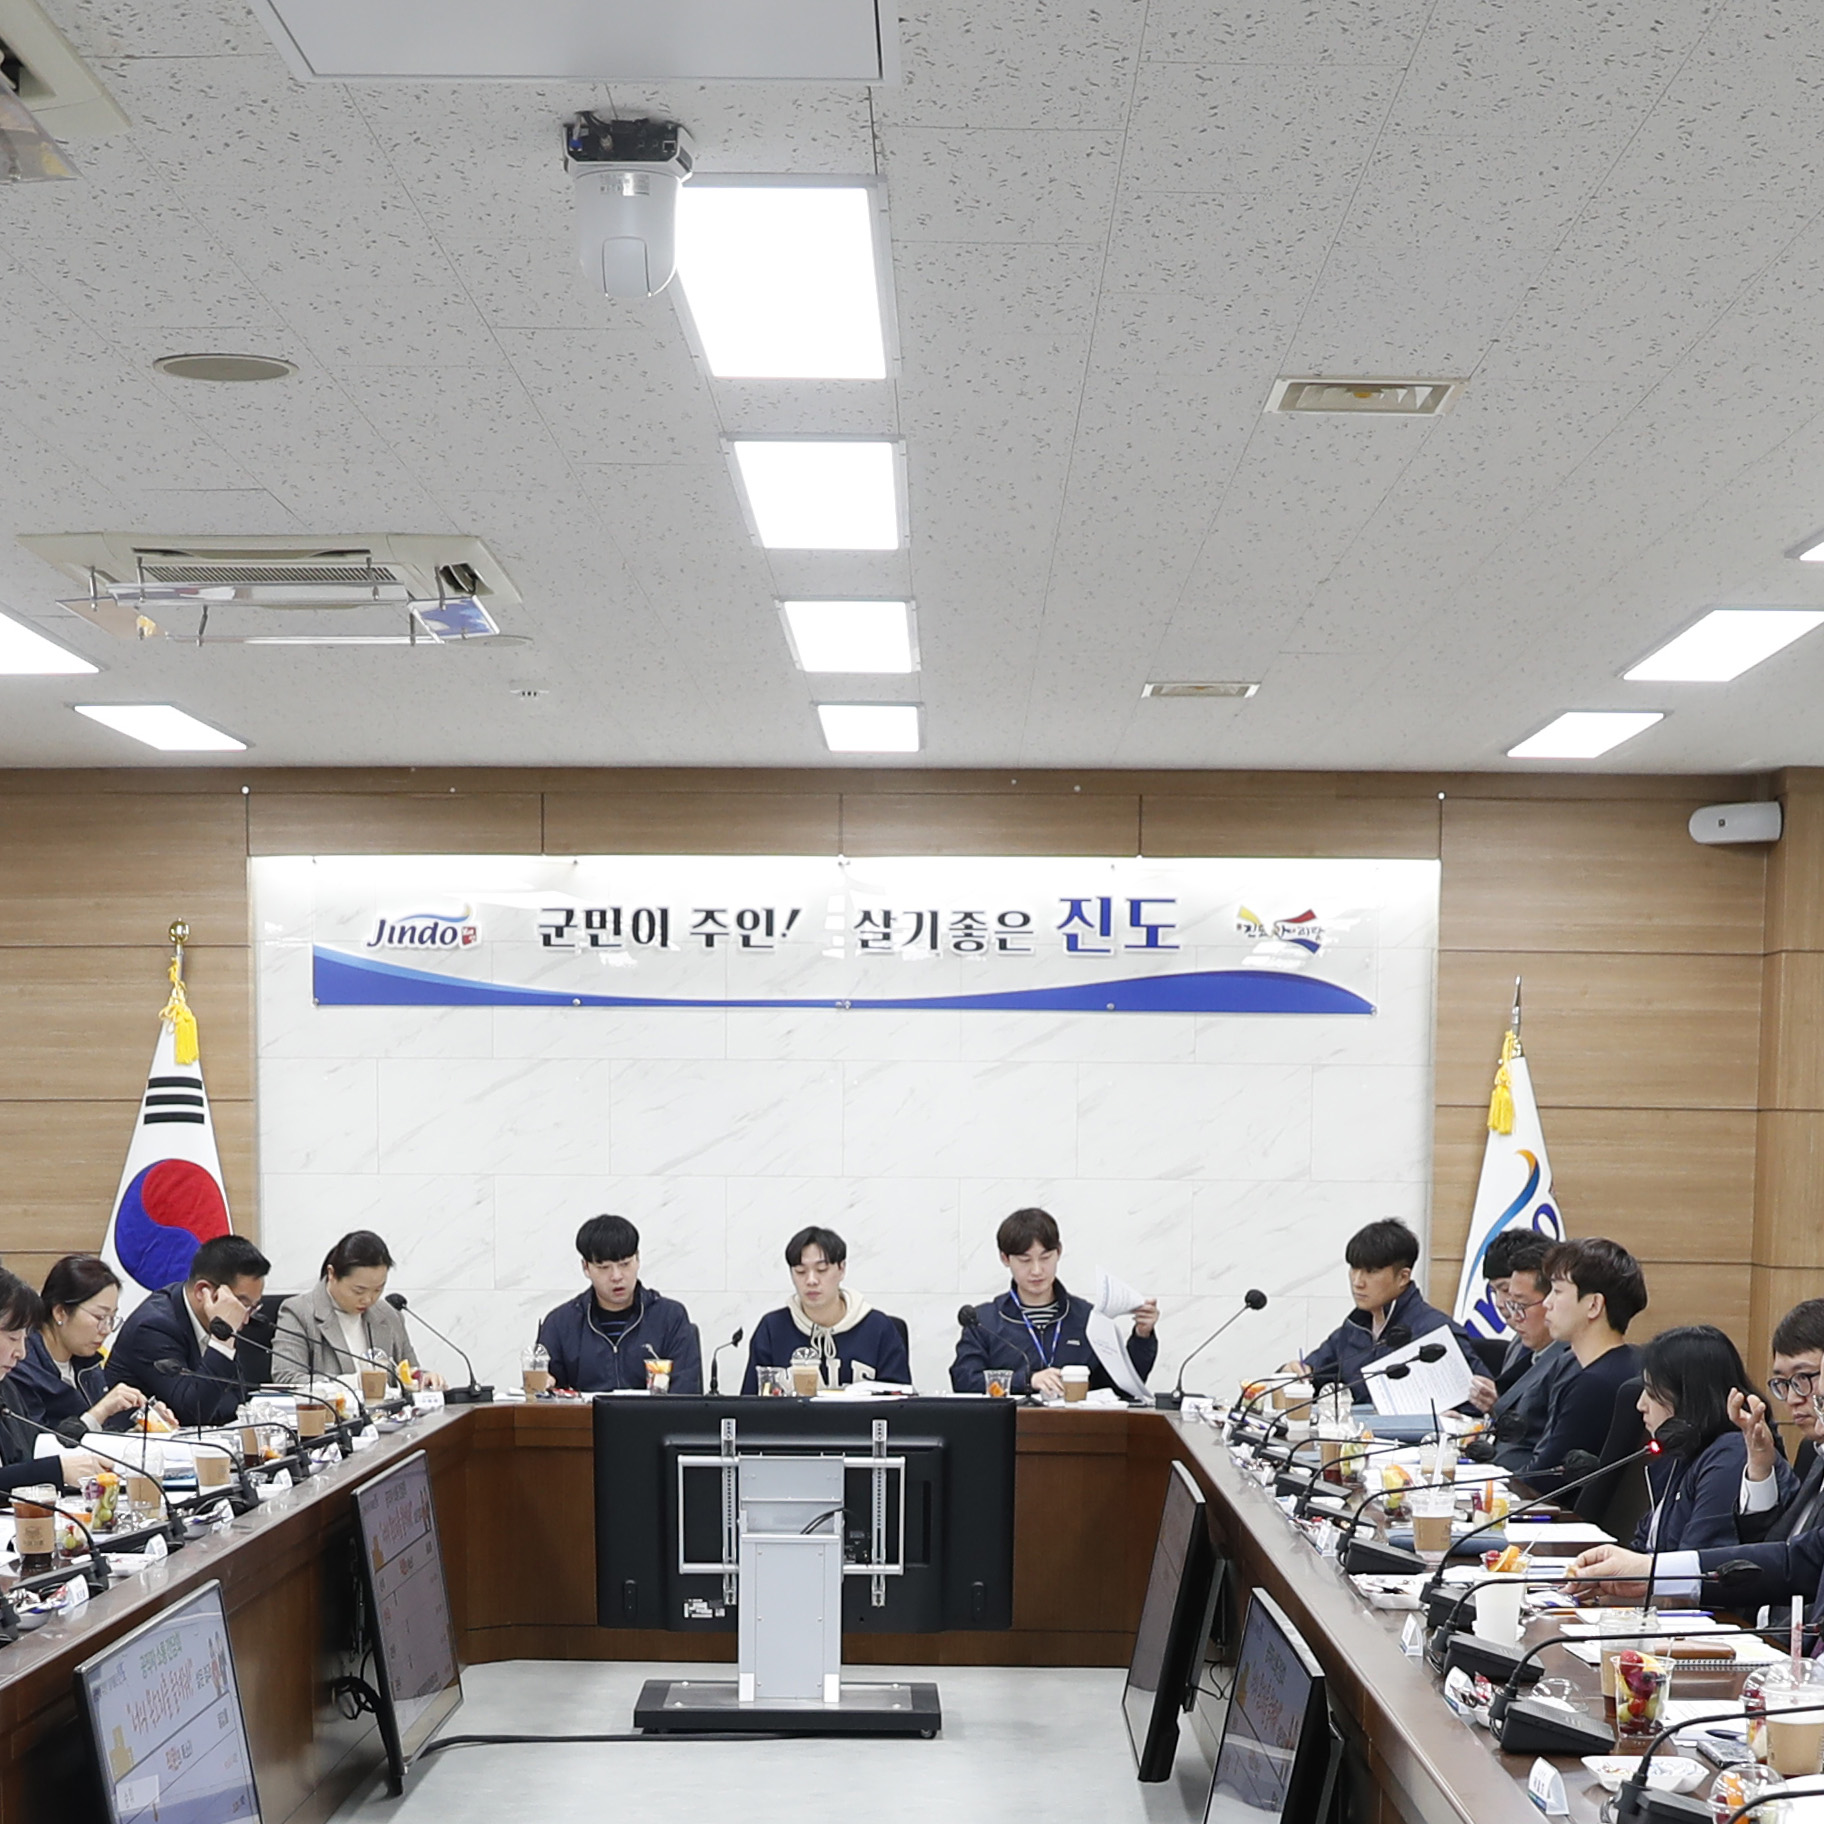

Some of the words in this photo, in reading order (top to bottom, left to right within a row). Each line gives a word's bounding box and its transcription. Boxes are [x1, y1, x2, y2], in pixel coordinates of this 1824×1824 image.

[366, 912, 461, 949] Jindo
[538, 906, 671, 949] 군민이
[689, 907, 803, 949] 주인!
[852, 907, 1034, 953] 살기좋은
[1056, 896, 1181, 953] 진도
